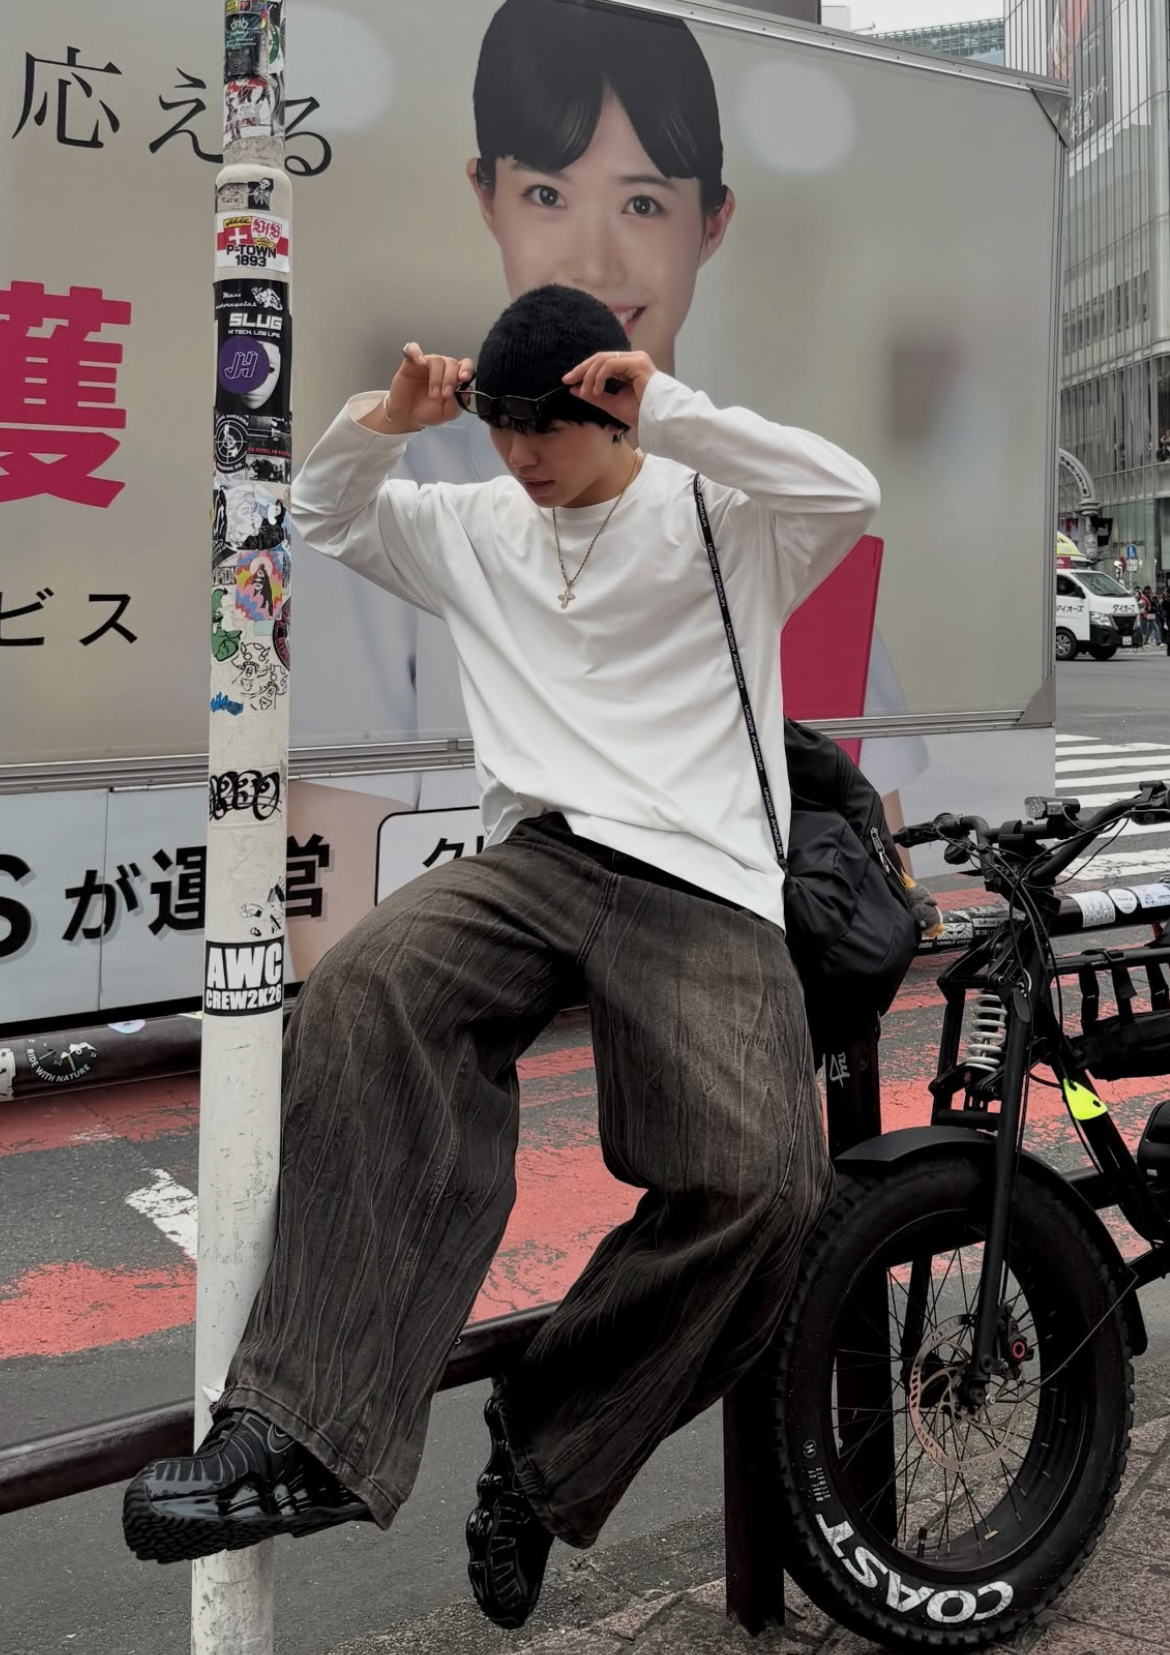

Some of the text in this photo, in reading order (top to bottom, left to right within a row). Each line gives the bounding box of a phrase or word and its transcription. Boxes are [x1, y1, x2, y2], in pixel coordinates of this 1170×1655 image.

[12, 46, 332, 176] 応える
[226, 244, 277, 259] P-TOWN
[235, 255, 267, 267] 1893
[228, 312, 283, 331] SLUG
[0, 587, 138, 646] ビス
[207, 942, 282, 990] AWC
[205, 985, 282, 1011] CREW2K26
[26, 1048, 91, 1082] RIDE WITH NATURE
[815, 1513, 1014, 1623] COAST
